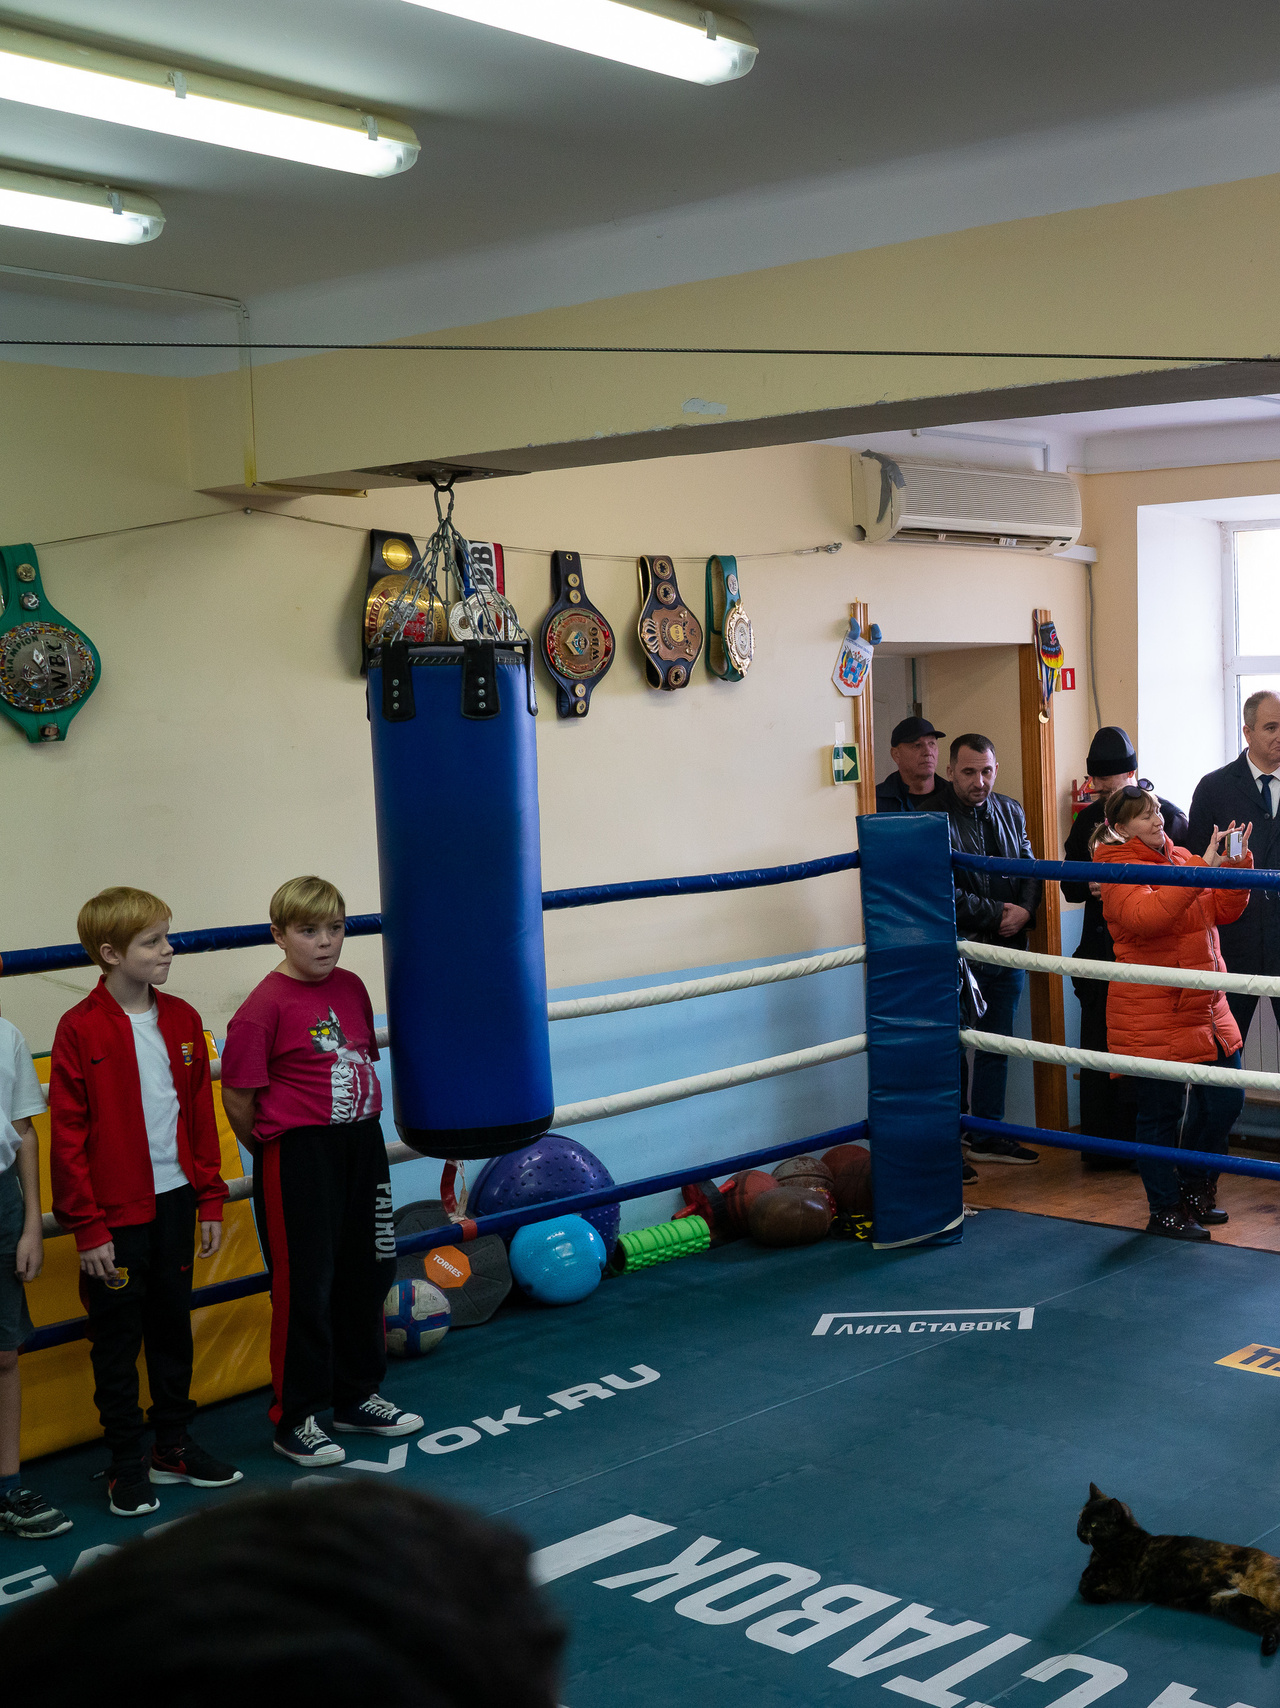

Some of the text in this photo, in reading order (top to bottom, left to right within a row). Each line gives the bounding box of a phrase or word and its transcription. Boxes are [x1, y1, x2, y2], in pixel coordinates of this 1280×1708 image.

[7, 635, 39, 680] CHAMPION
[45, 637, 69, 691] WBC
[432, 1253, 464, 1279] TORRES
[593, 1533, 1129, 1708] СТАВОК
